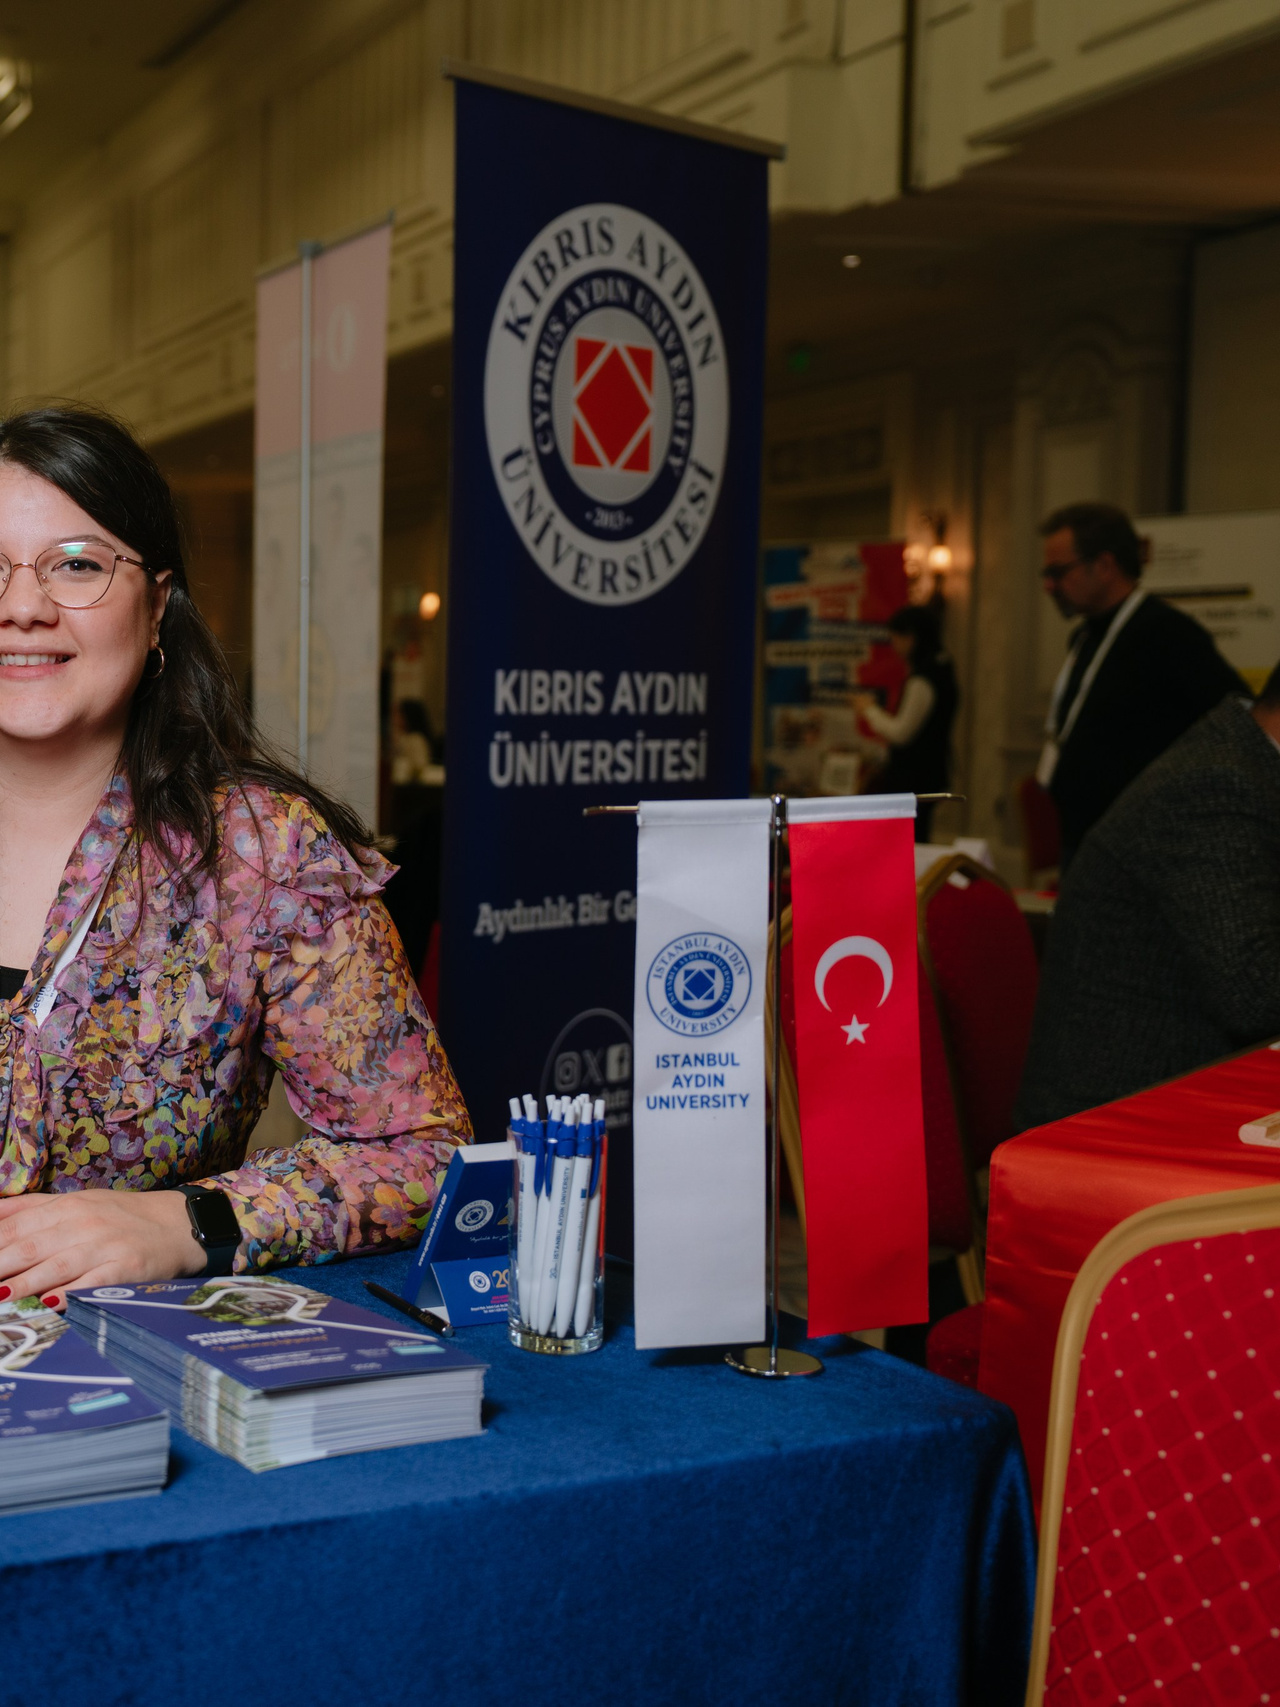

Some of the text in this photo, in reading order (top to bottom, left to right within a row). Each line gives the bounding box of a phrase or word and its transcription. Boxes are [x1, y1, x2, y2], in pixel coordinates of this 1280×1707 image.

[502, 216, 718, 369] KIBRIS AYDIN
[531, 275, 693, 477] CYPRUS AYDIN UNIVERSITY
[494, 669, 707, 715] KIBRIS AYDIN
[489, 730, 708, 788] ÜNİVERSİTESİ
[577, 892, 612, 926] Bir
[653, 937, 746, 979] ISTANBUL AYDIN
[660, 1003, 736, 1034] UNIVERSITY
[655, 1052, 740, 1069] ISTANBUL
[671, 1073, 725, 1088] AYDIN
[646, 1093, 750, 1110] UNIVERSITY
[560, 1166, 571, 1206] UNIVERSITY
[557, 1207, 565, 1228] AYDIN
[553, 1229, 563, 1260] ISTANBUL
